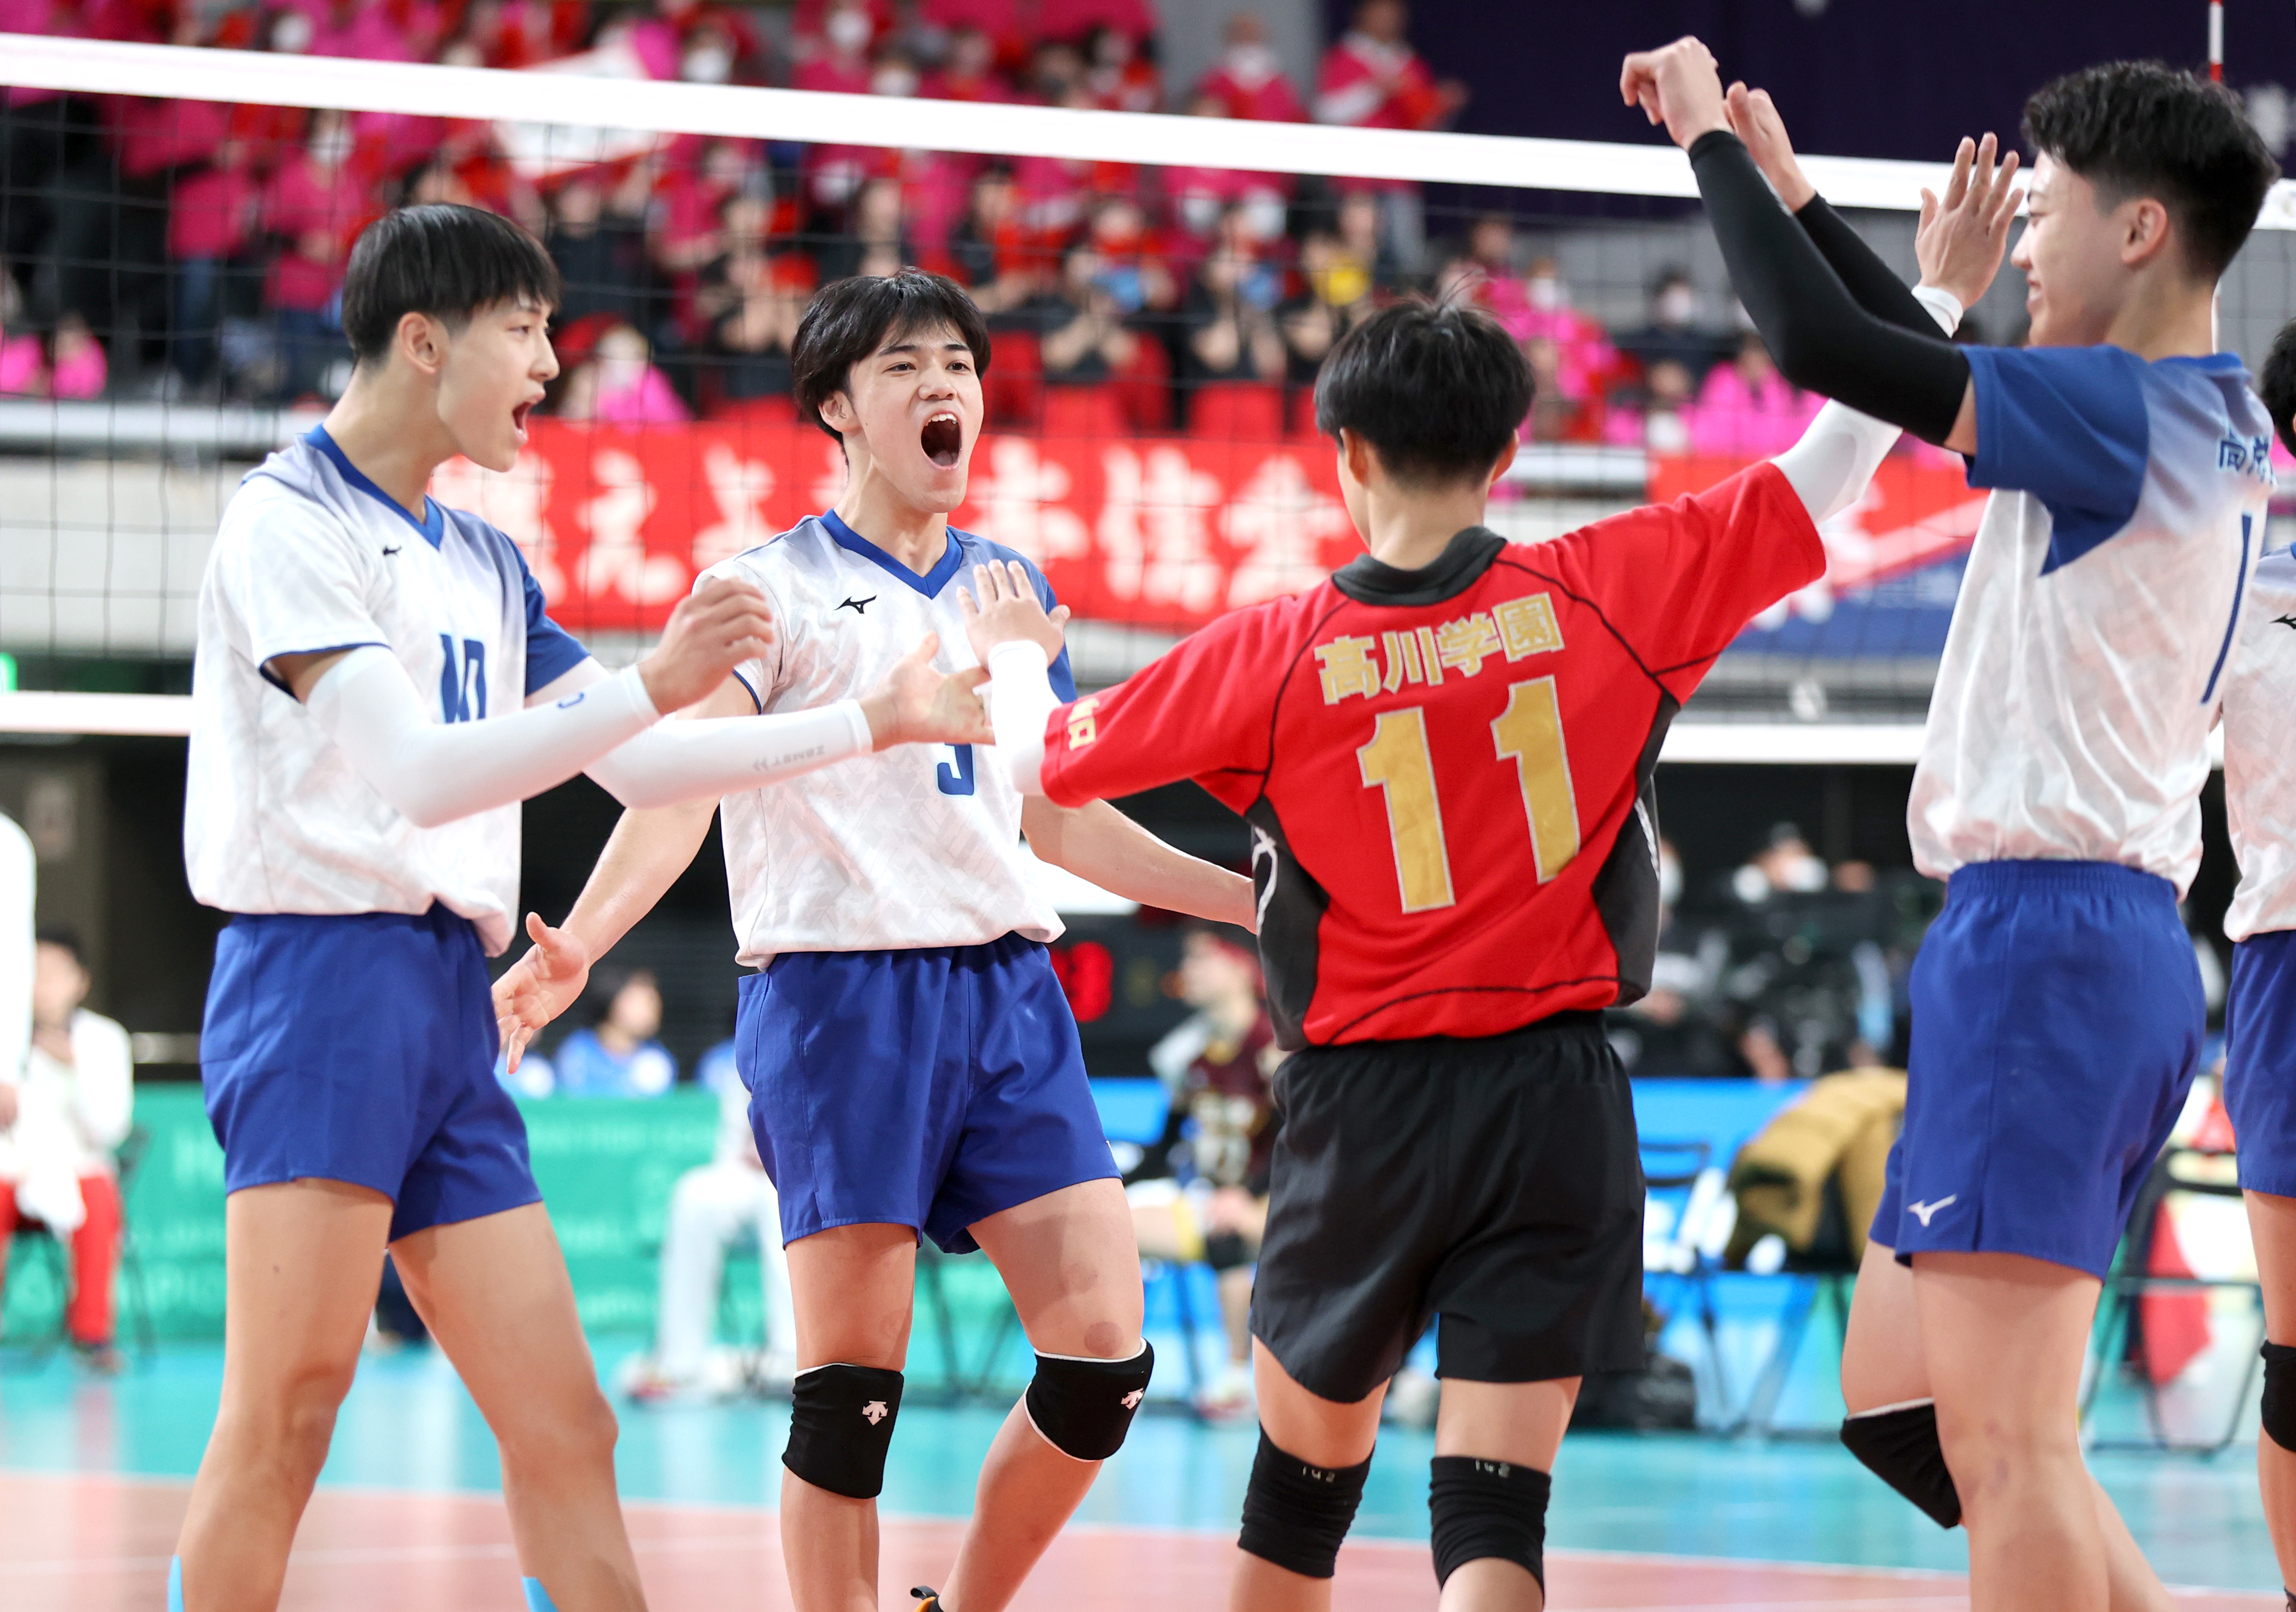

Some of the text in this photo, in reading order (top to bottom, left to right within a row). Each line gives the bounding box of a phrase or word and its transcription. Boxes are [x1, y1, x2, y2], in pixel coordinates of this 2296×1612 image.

[1314, 591, 1565, 705] 高川学園
[1357, 675, 1580, 914] 11
